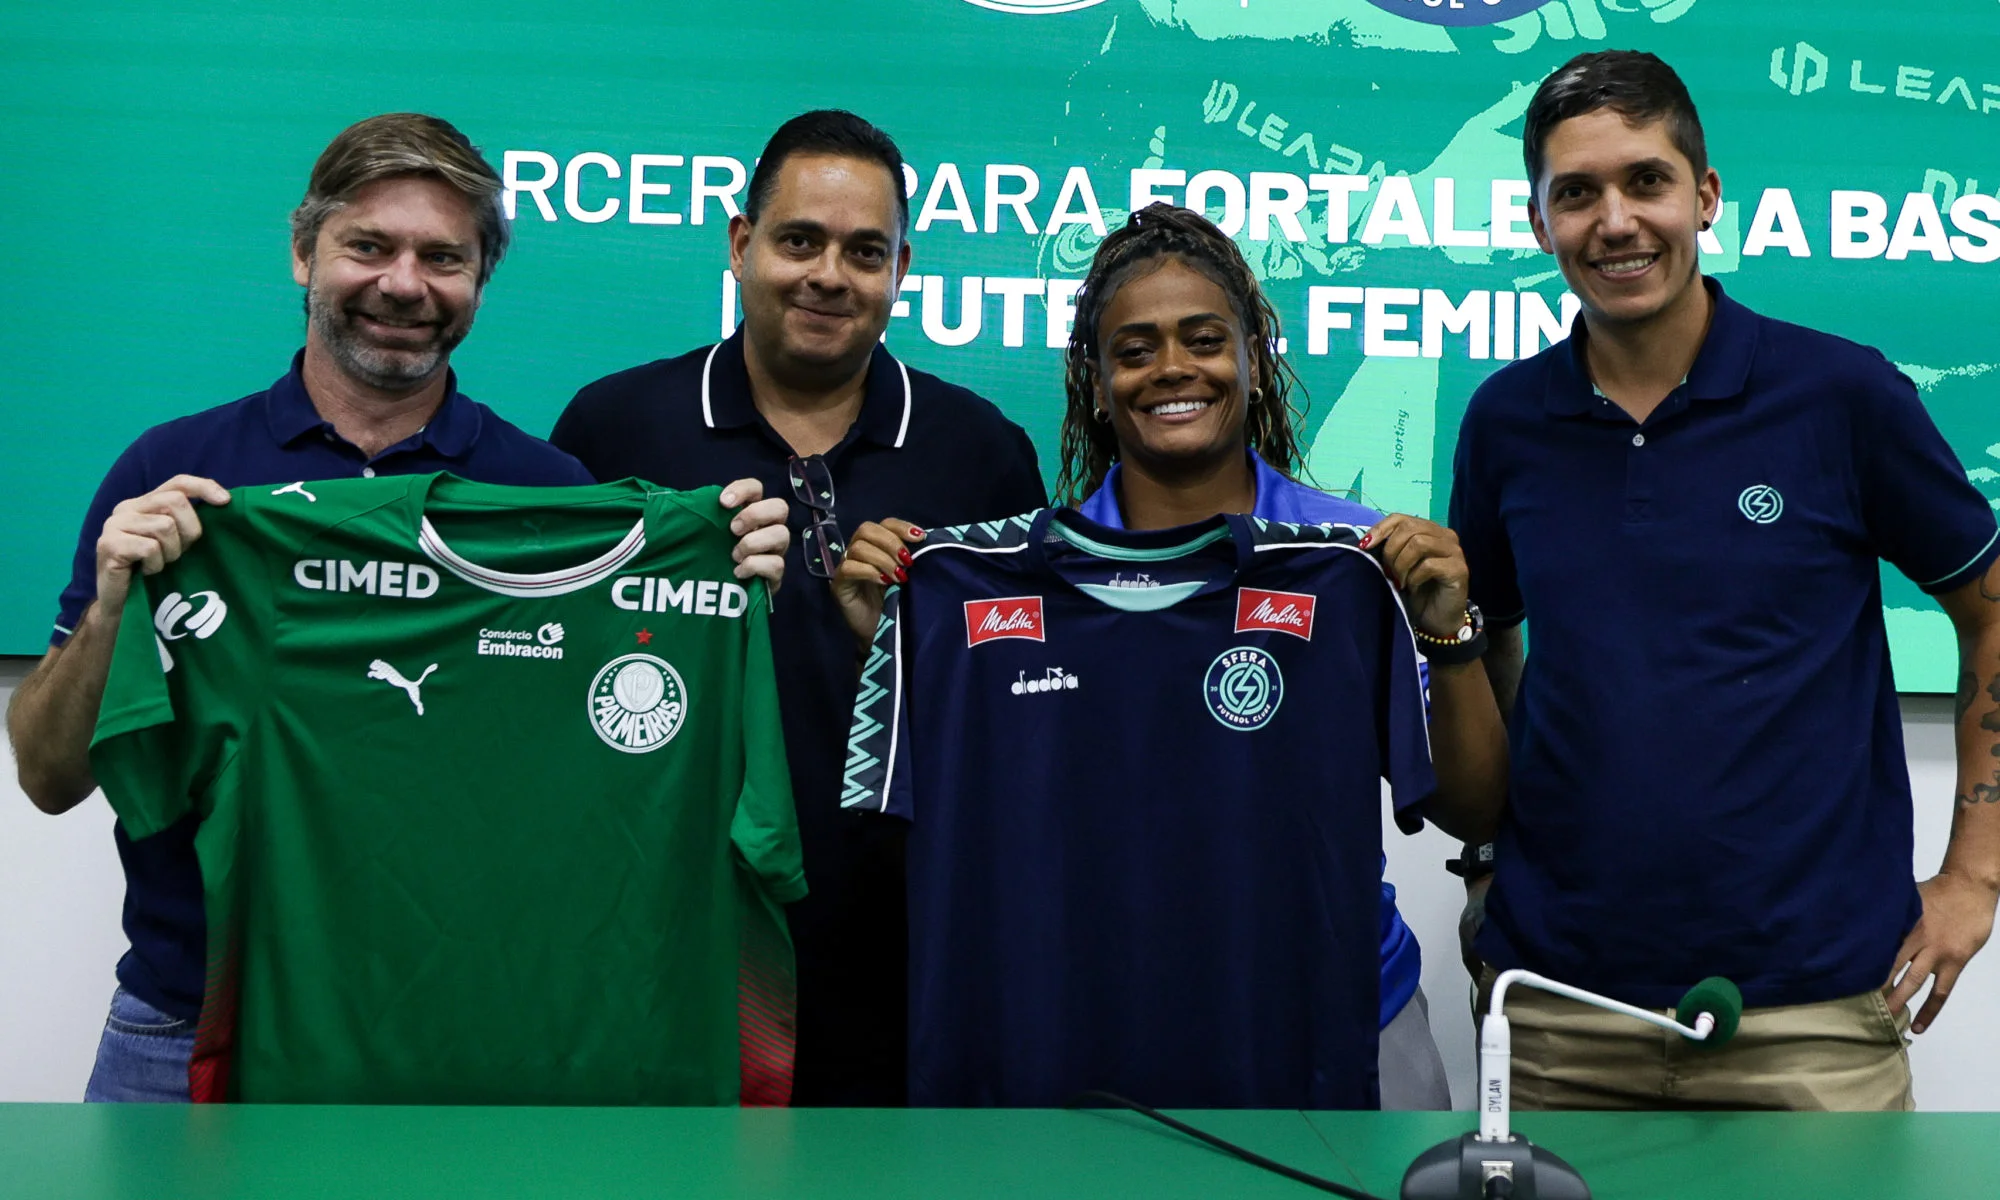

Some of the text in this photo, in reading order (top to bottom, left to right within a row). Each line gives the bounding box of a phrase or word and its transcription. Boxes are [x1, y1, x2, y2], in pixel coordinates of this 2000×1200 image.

[502, 150, 758, 226] RCER
[901, 162, 1107, 236] ARA
[1742, 188, 1811, 257] A
[1830, 190, 2000, 263] BAS
[1308, 286, 1582, 360] FEMIN
[294, 560, 440, 599] CIMED
[611, 576, 748, 618] CIMED
[1246, 597, 1304, 627] Melitta
[479, 628, 533, 640] Consórcio
[977, 605, 1035, 634] Melitta
[478, 639, 563, 659] Embracon
[1222, 651, 1267, 668] SFERA
[1011, 667, 1079, 695] diadora
[594, 695, 681, 747] PALMEIRAS
[1489, 1079, 1502, 1113] DYLAN
